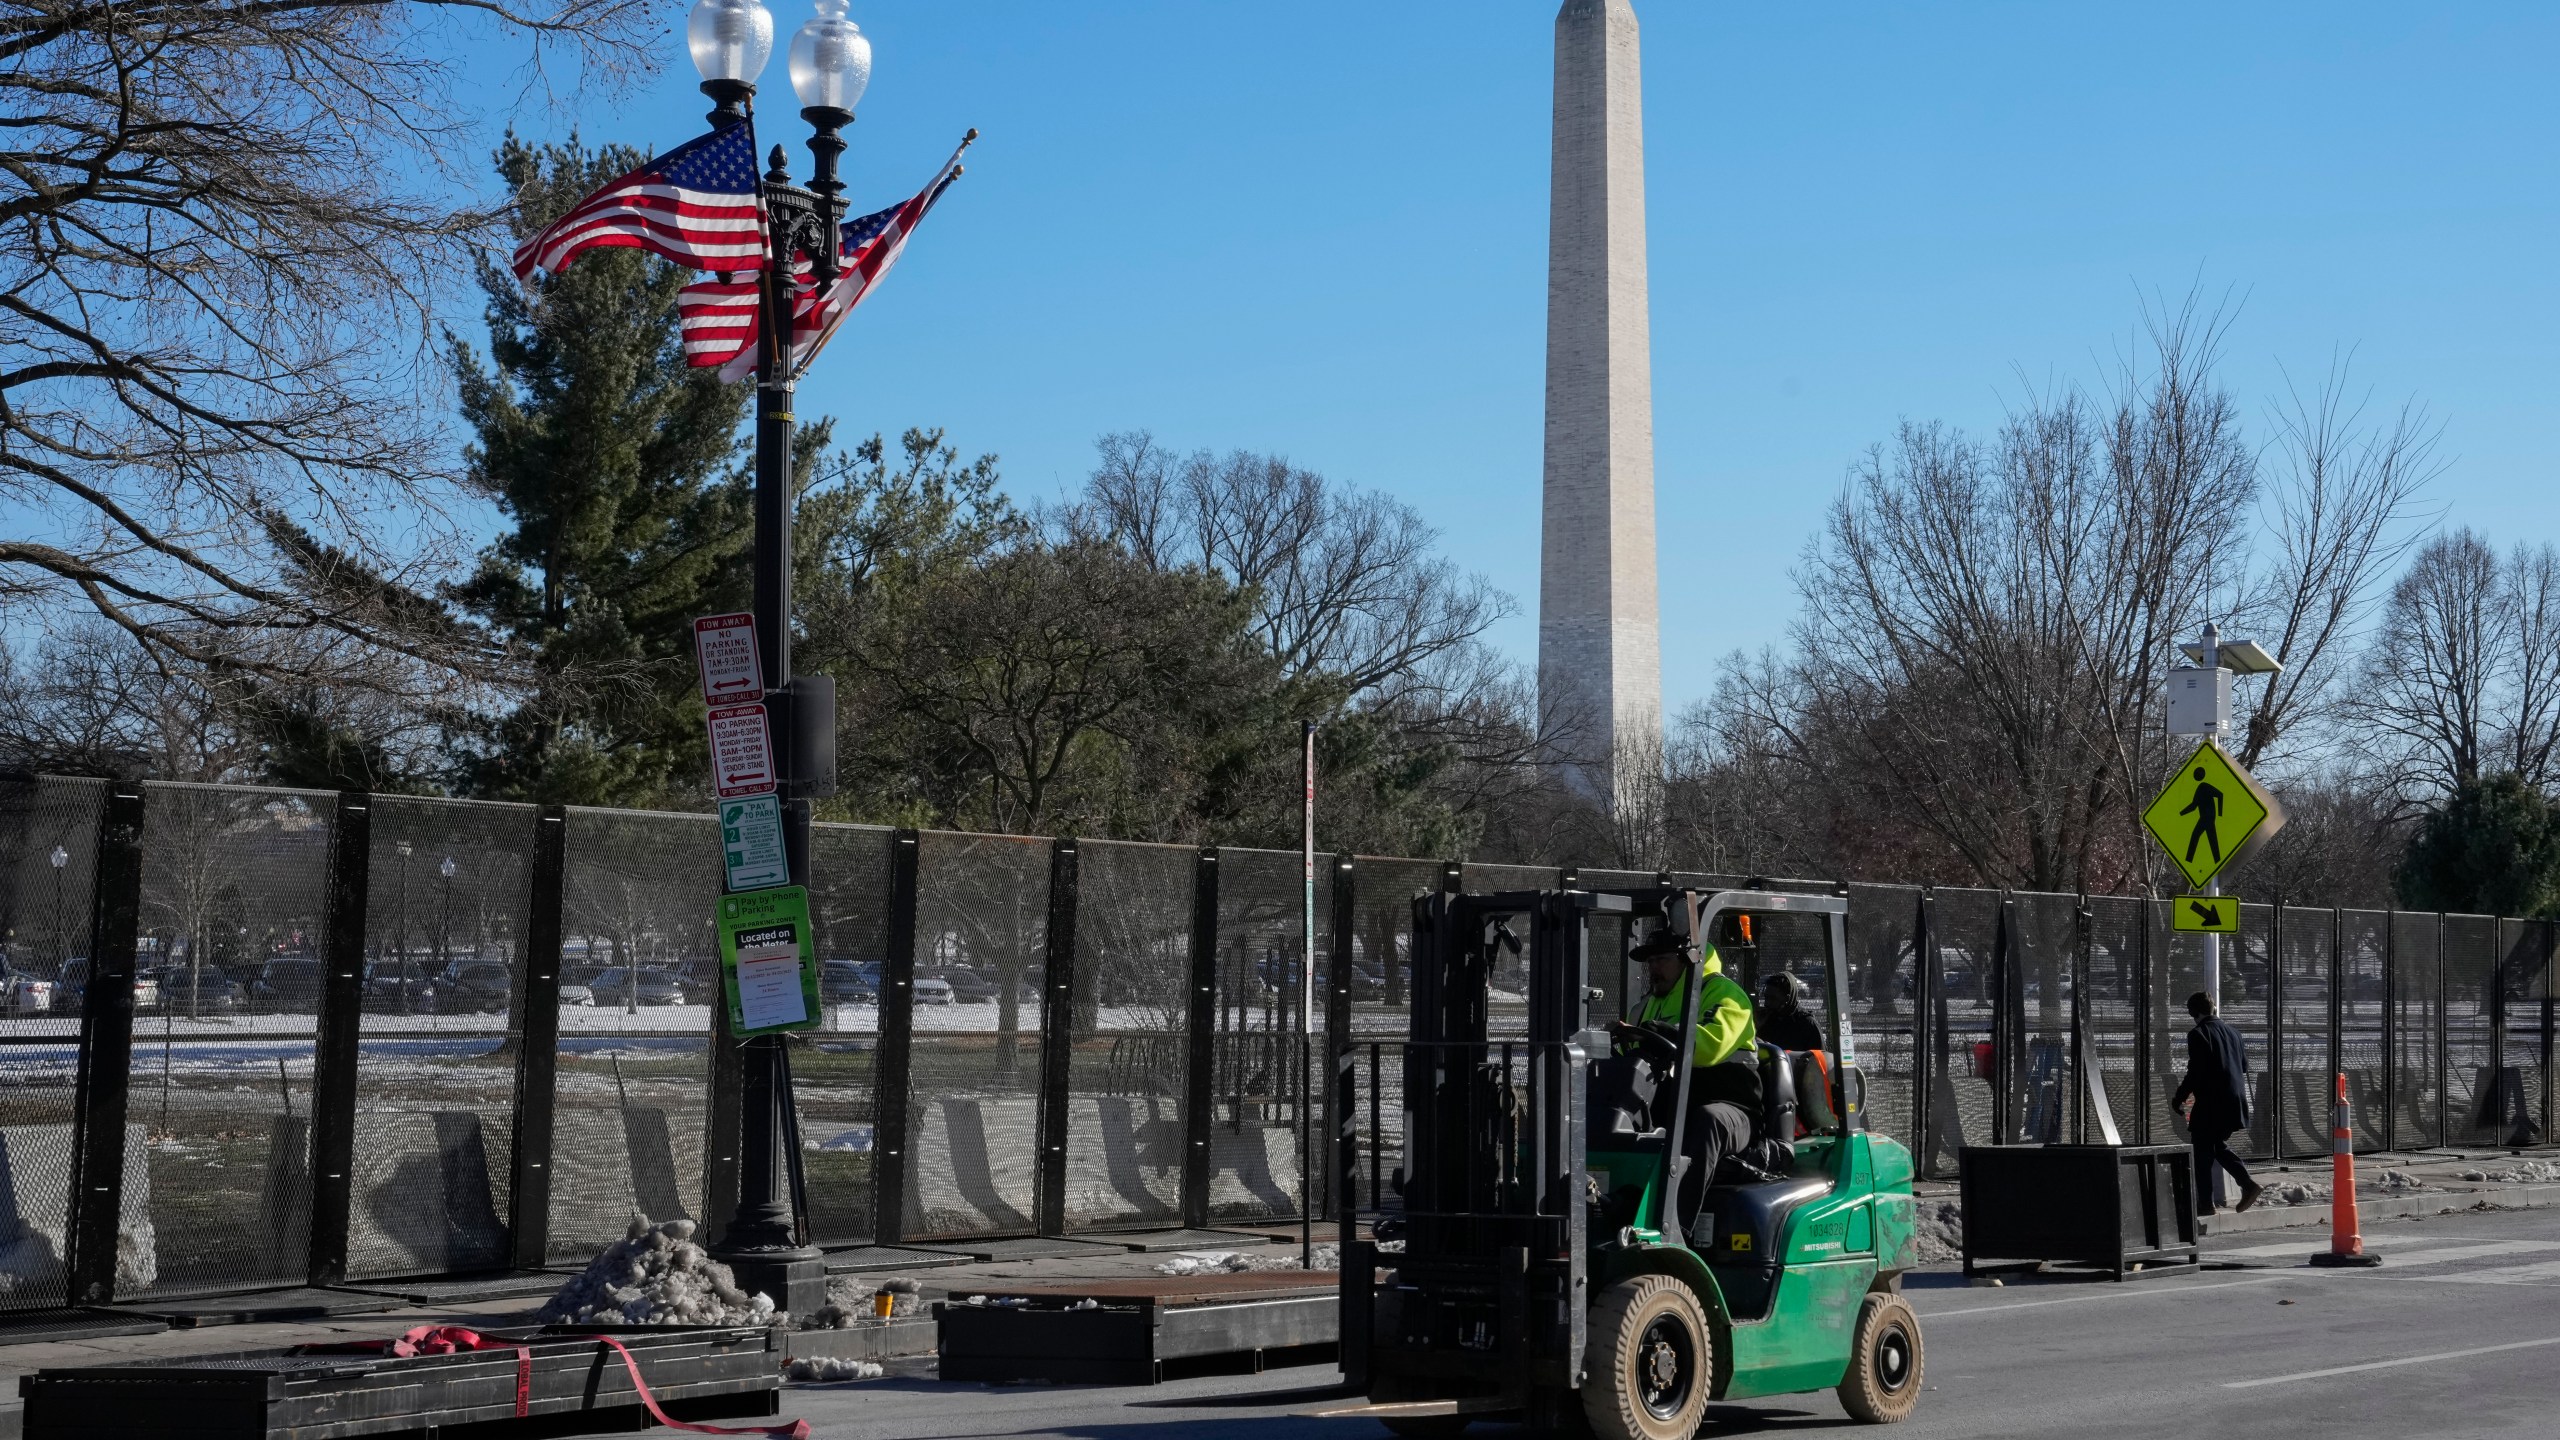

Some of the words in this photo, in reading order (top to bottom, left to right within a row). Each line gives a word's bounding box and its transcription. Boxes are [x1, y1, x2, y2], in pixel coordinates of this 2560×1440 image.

[702, 620, 719, 629] TOW
[722, 617, 745, 627] AWAY
[706, 638, 747, 650] PARKING
[718, 646, 749, 657] STANDING
[710, 666, 750, 676] MONDAY-FRIDAY
[730, 717, 761, 728] PARKING
[717, 727, 762, 739] 9:30AM-6:30PM
[719, 737, 761, 747] MONDAY-FRIDAY
[721, 744, 762, 756] 8AM-10PM
[722, 753, 762, 764] SATURDAY-SUNDAY
[723, 764, 745, 773] VENDOR
[748, 761, 764, 770] STAND
[750, 803, 766, 811] PAY
[756, 810, 775, 818] PARK
[730, 830, 736, 841] 2
[741, 897, 756, 906] Pay
[759, 896, 770, 904] by
[772, 892, 800, 902] Phone
[742, 904, 775, 915] Parking
[741, 930, 776, 943] Located
[1804, 1242, 1841, 1251] MITSUBISHI
